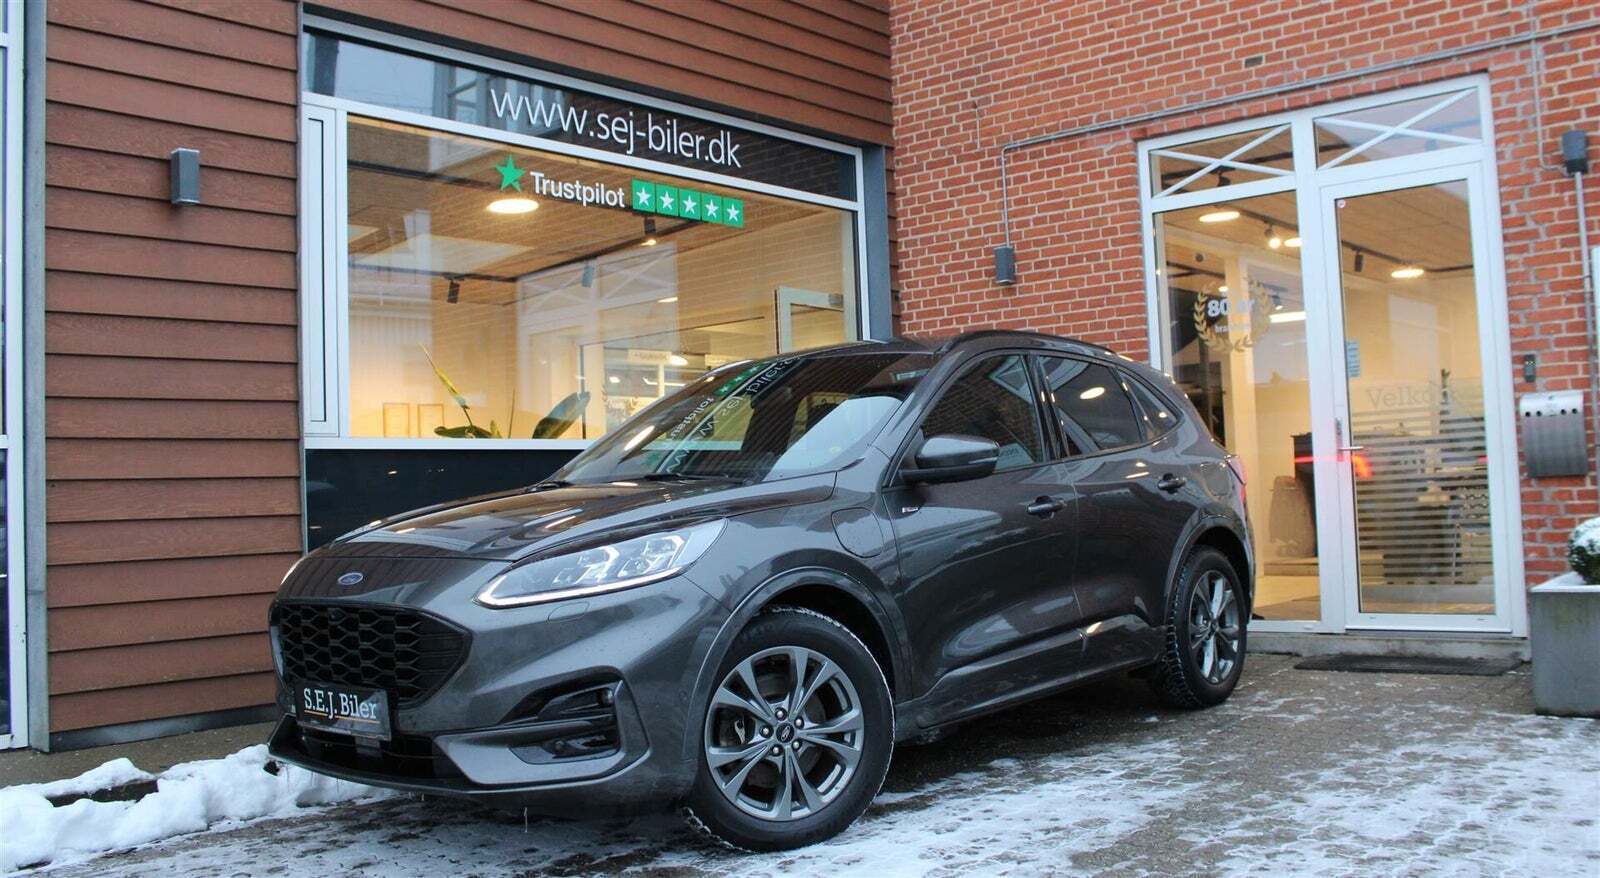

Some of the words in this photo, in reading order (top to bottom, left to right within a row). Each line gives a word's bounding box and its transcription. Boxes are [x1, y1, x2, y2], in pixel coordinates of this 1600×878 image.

[490, 88, 742, 169] www.sej-biler.dk
[529, 171, 626, 208] Trustpilot
[1207, 299, 1231, 317] 80
[303, 687, 338, 719] S.E.J.
[339, 692, 377, 719] Biler
